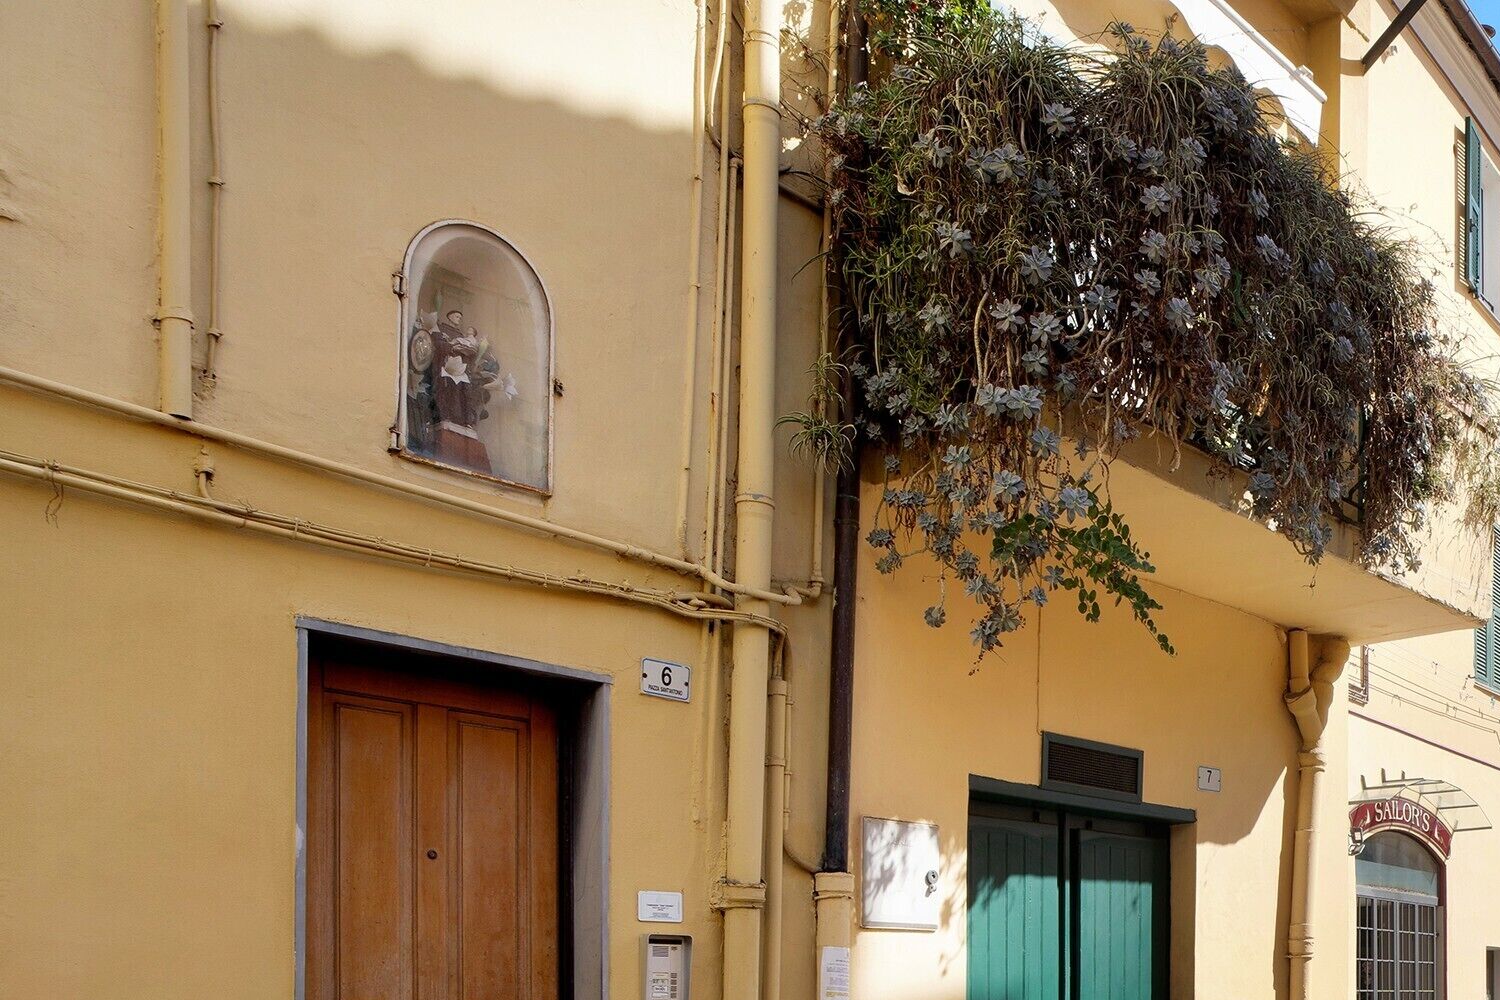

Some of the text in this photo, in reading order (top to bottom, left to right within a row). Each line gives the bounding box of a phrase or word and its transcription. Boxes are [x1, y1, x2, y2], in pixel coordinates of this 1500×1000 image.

[661, 666, 672, 687] 6
[1207, 769, 1212, 783] 7
[1374, 800, 1431, 832] SAILOR'S
